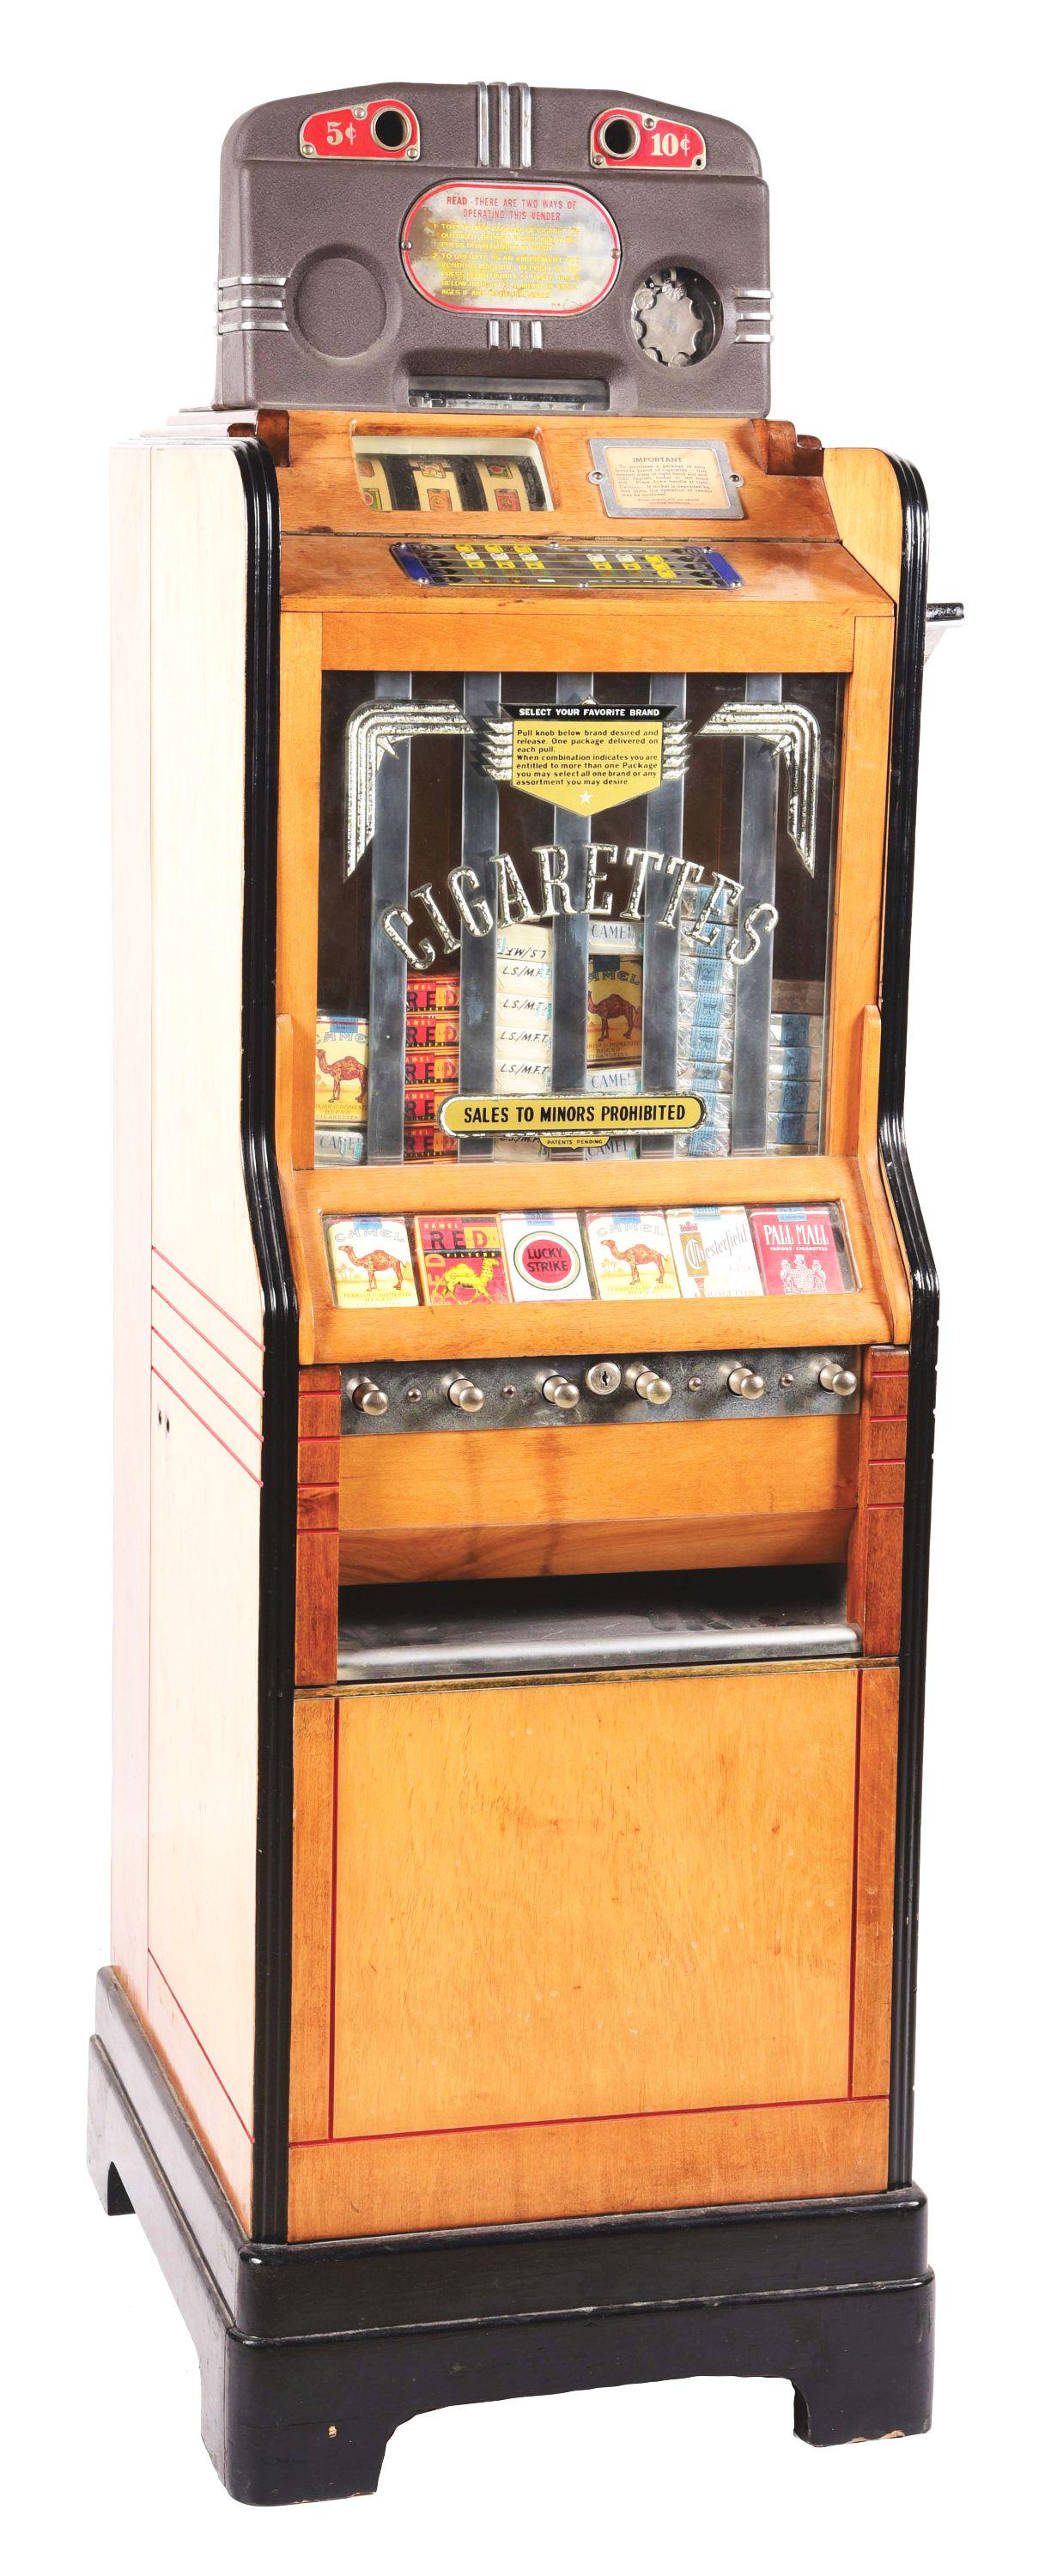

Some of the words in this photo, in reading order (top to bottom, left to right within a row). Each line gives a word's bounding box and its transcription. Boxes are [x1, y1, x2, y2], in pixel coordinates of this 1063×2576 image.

[326, 121, 357, 146] 5¢
[650, 132, 691, 156] 10¢
[446, 196, 468, 205] READ
[475, 197, 499, 207] THERE
[502, 198, 518, 208] ARE
[521, 198, 539, 208] TWO
[542, 199, 563, 209] WAYS
[567, 200, 577, 210] OF
[463, 209, 505, 219] OPERATING
[509, 210, 526, 220] THIS
[532, 211, 561, 221] VENDER
[623, 762, 658, 770] Package
[380, 843, 780, 970] CIGARETTES
[588, 970, 641, 986] AMEL
[316, 1032, 370, 1045] AME
[404, 1100, 434, 1117] RE
[464, 1106, 509, 1123] SALES
[516, 1106, 534, 1122] TO
[540, 1106, 595, 1122] MINORS
[601, 1104, 686, 1121] PROHIBITED
[335, 1229, 405, 1242] CAMEL
[596, 1223, 665, 1237] CAMEL
[762, 1224, 794, 1245] PALL
[795, 1224, 829, 1245] MALL
[430, 1230, 488, 1250] RED
[685, 1221, 749, 1270] Chesterfield
[527, 1247, 563, 1261] LUCKY
[526, 1261, 568, 1273] STRIKE
